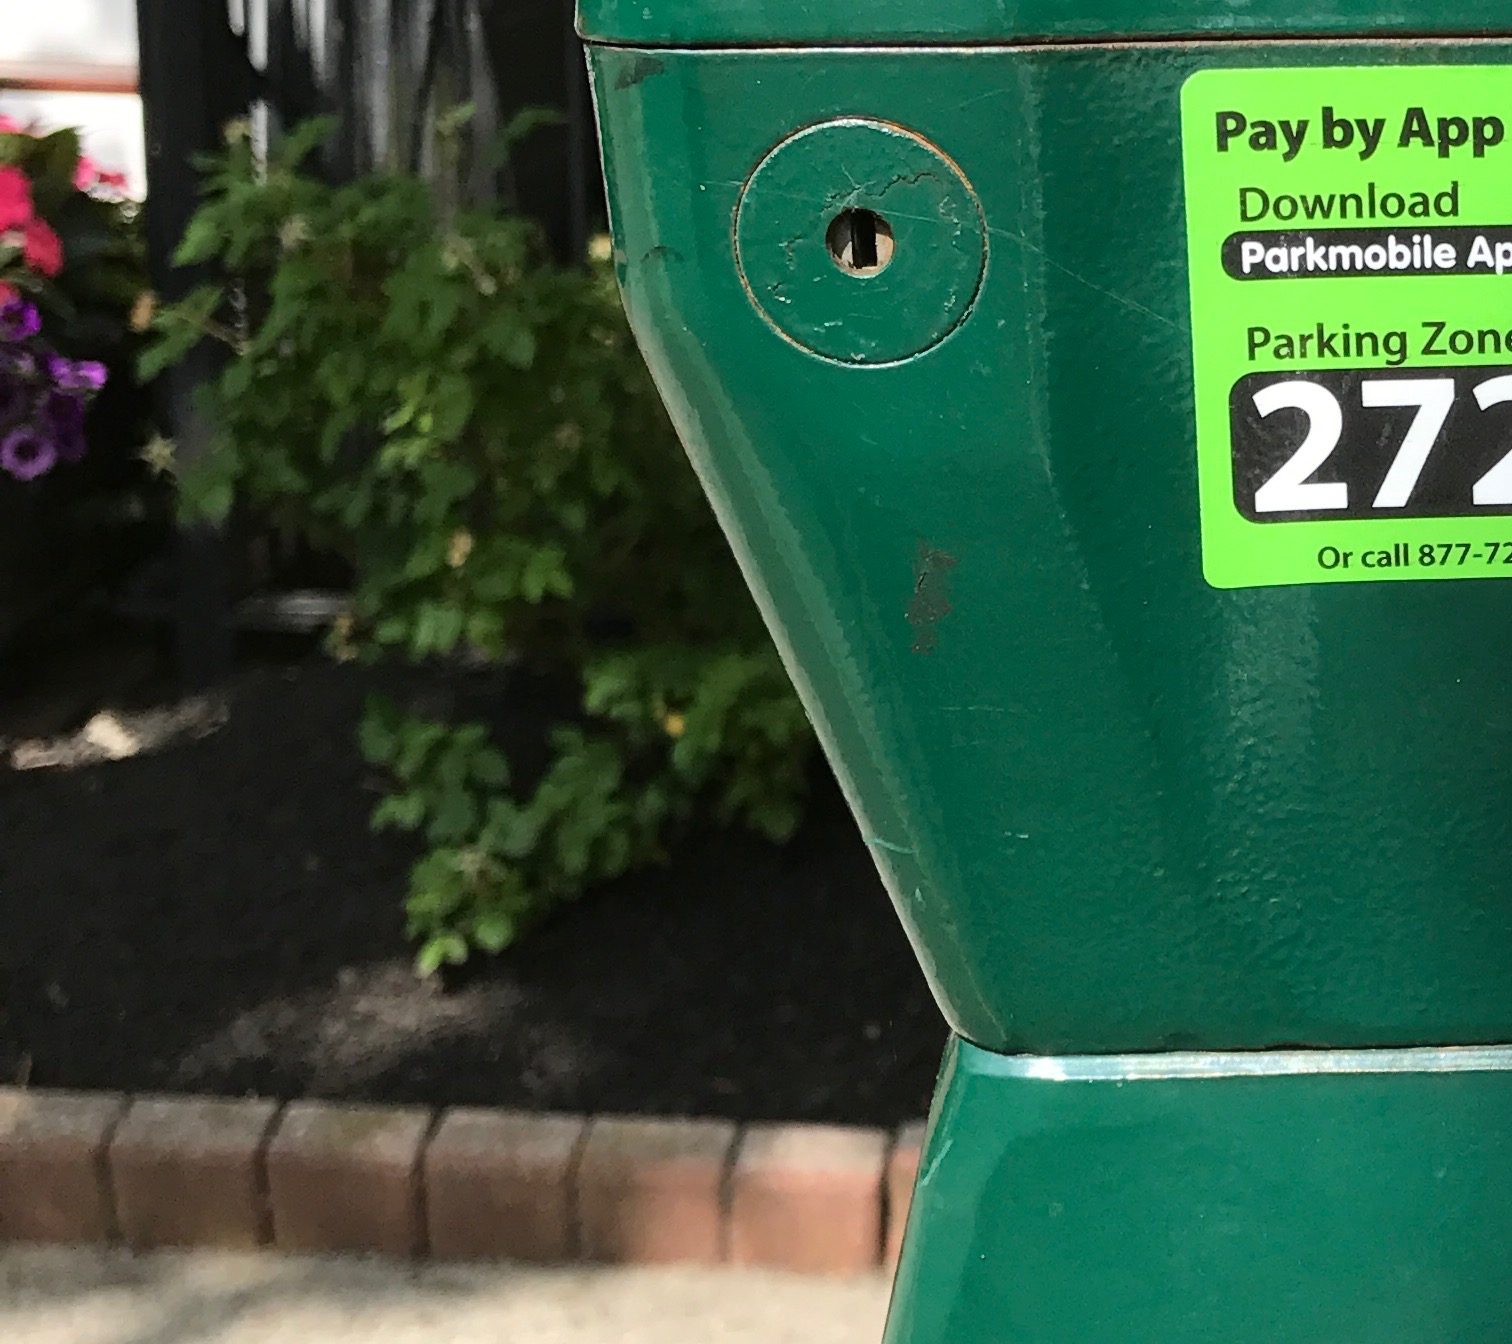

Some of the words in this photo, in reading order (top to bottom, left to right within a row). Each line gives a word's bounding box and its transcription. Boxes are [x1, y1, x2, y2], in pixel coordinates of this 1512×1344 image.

[1216, 110, 1310, 162] Pay
[1322, 106, 1386, 161] by
[1398, 107, 1505, 159] App
[1239, 180, 1460, 223] Download
[1241, 233, 1457, 274] Parkmobile
[1247, 322, 1408, 365] Parking
[1317, 546, 1354, 570] Or
[1361, 542, 1410, 568] call
